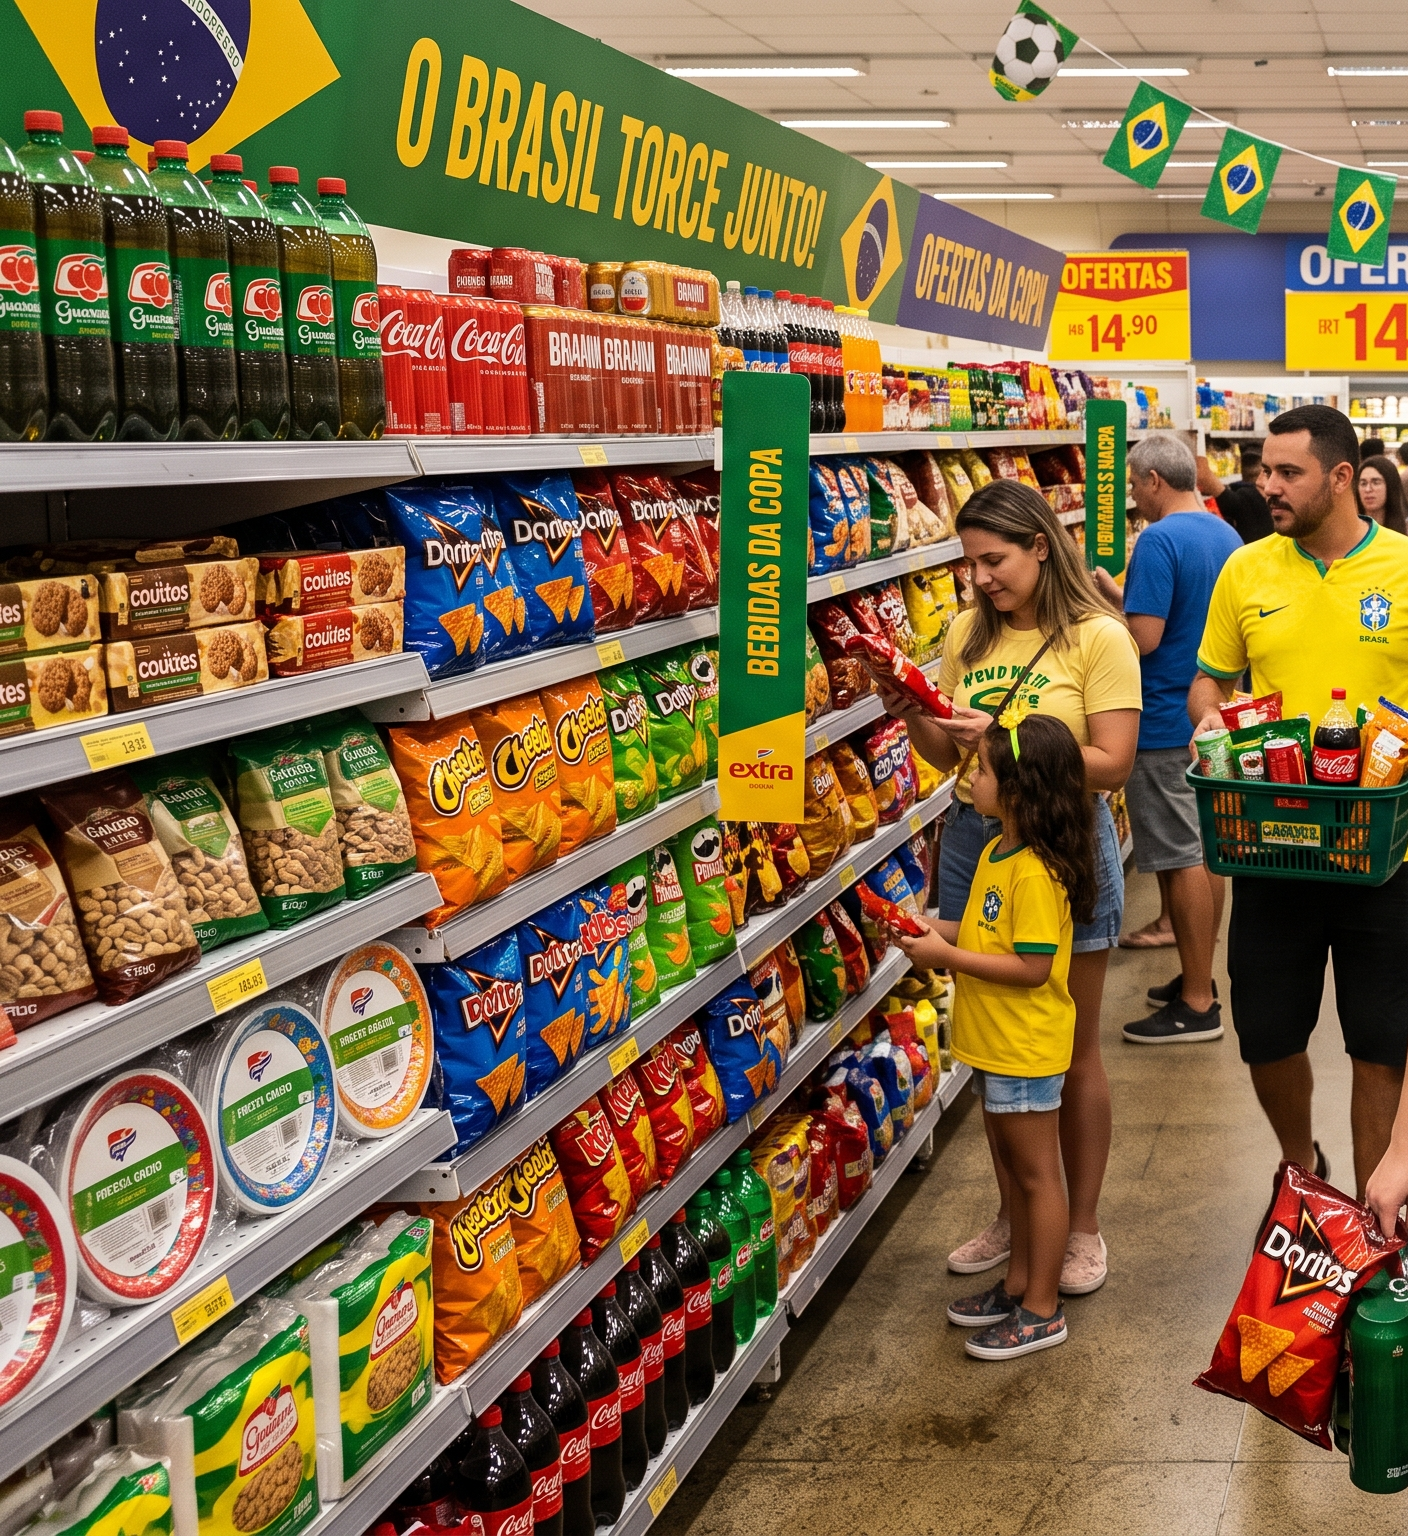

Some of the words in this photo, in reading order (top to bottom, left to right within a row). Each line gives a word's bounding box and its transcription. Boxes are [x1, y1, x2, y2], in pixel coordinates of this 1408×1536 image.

[396, 37, 442, 168] O
[445, 54, 604, 214] BRASIL
[613, 114, 729, 243] TORCE
[723, 161, 828, 270] JUNTO!
[915, 233, 991, 314] OFERTAS
[987, 257, 1013, 320] DA
[1061, 262, 1173, 290] OFERTAS
[749, 448, 783, 515] COPA
[748, 522, 781, 557] DA
[747, 562, 780, 677] BEBIDAS
[729, 761, 793, 780] extra
[1263, 1224, 1357, 1293] Doritos
